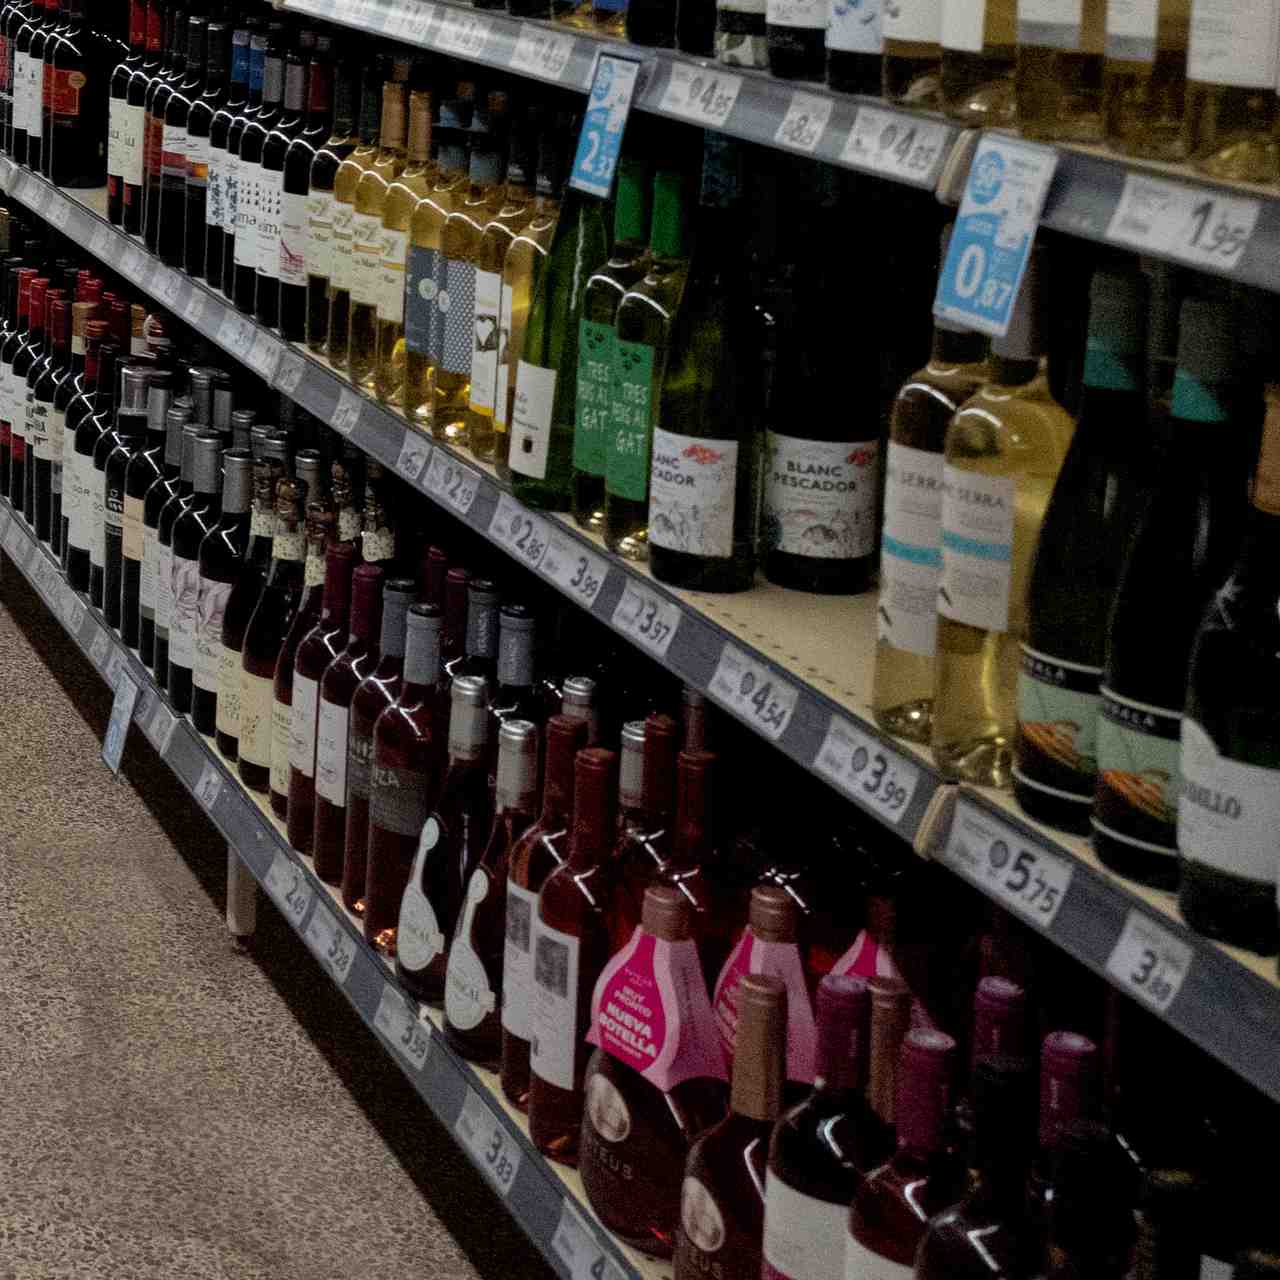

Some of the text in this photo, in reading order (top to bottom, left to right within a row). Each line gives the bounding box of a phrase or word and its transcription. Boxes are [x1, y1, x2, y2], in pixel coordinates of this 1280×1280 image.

[773, 472, 857, 493] PESCADOR
[786, 460, 843, 479] BLANC
[1005, 850, 1059, 913] 5,75
[607, 1002, 652, 1040] NUEVA
